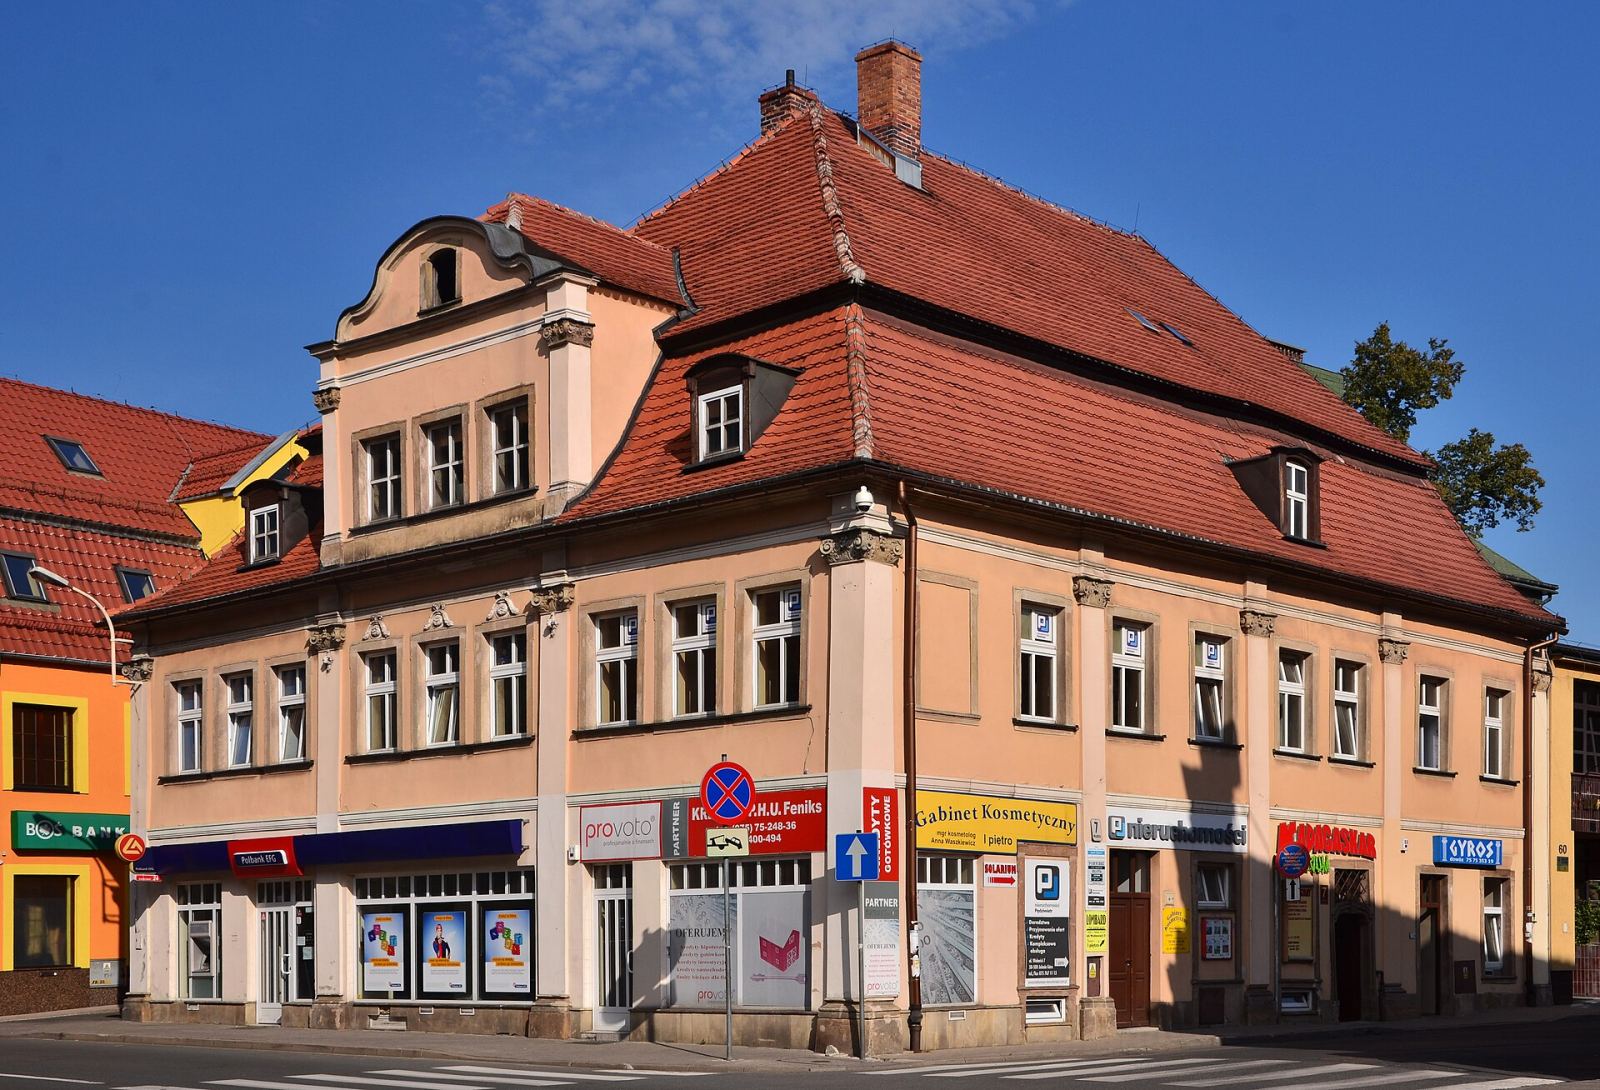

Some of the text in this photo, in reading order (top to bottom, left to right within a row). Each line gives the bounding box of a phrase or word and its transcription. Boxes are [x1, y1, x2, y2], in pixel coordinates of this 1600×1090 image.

[783, 800, 822, 815] Feniks
[915, 804, 1076, 836] Gabinet Kosmetyczny
[72, 826, 126, 839] BANK
[672, 801, 680, 856] PARTNER
[754, 822, 797, 832] 75-248-36
[1127, 817, 1247, 845] nieruchomości
[883, 795, 892, 873] GOTÓWKOWE
[947, 831, 976, 839] kosmetolog
[945, 838, 976, 846] Waszkiewicz
[1449, 839, 1494, 858] GYROS
[1558, 844, 1567, 854] 60
[241, 854, 276, 864] Polbank EFG
[985, 863, 1017, 874] SOLARIUM
[865, 898, 898, 907] PARTNER
[676, 928, 734, 938] OFERUJEM
